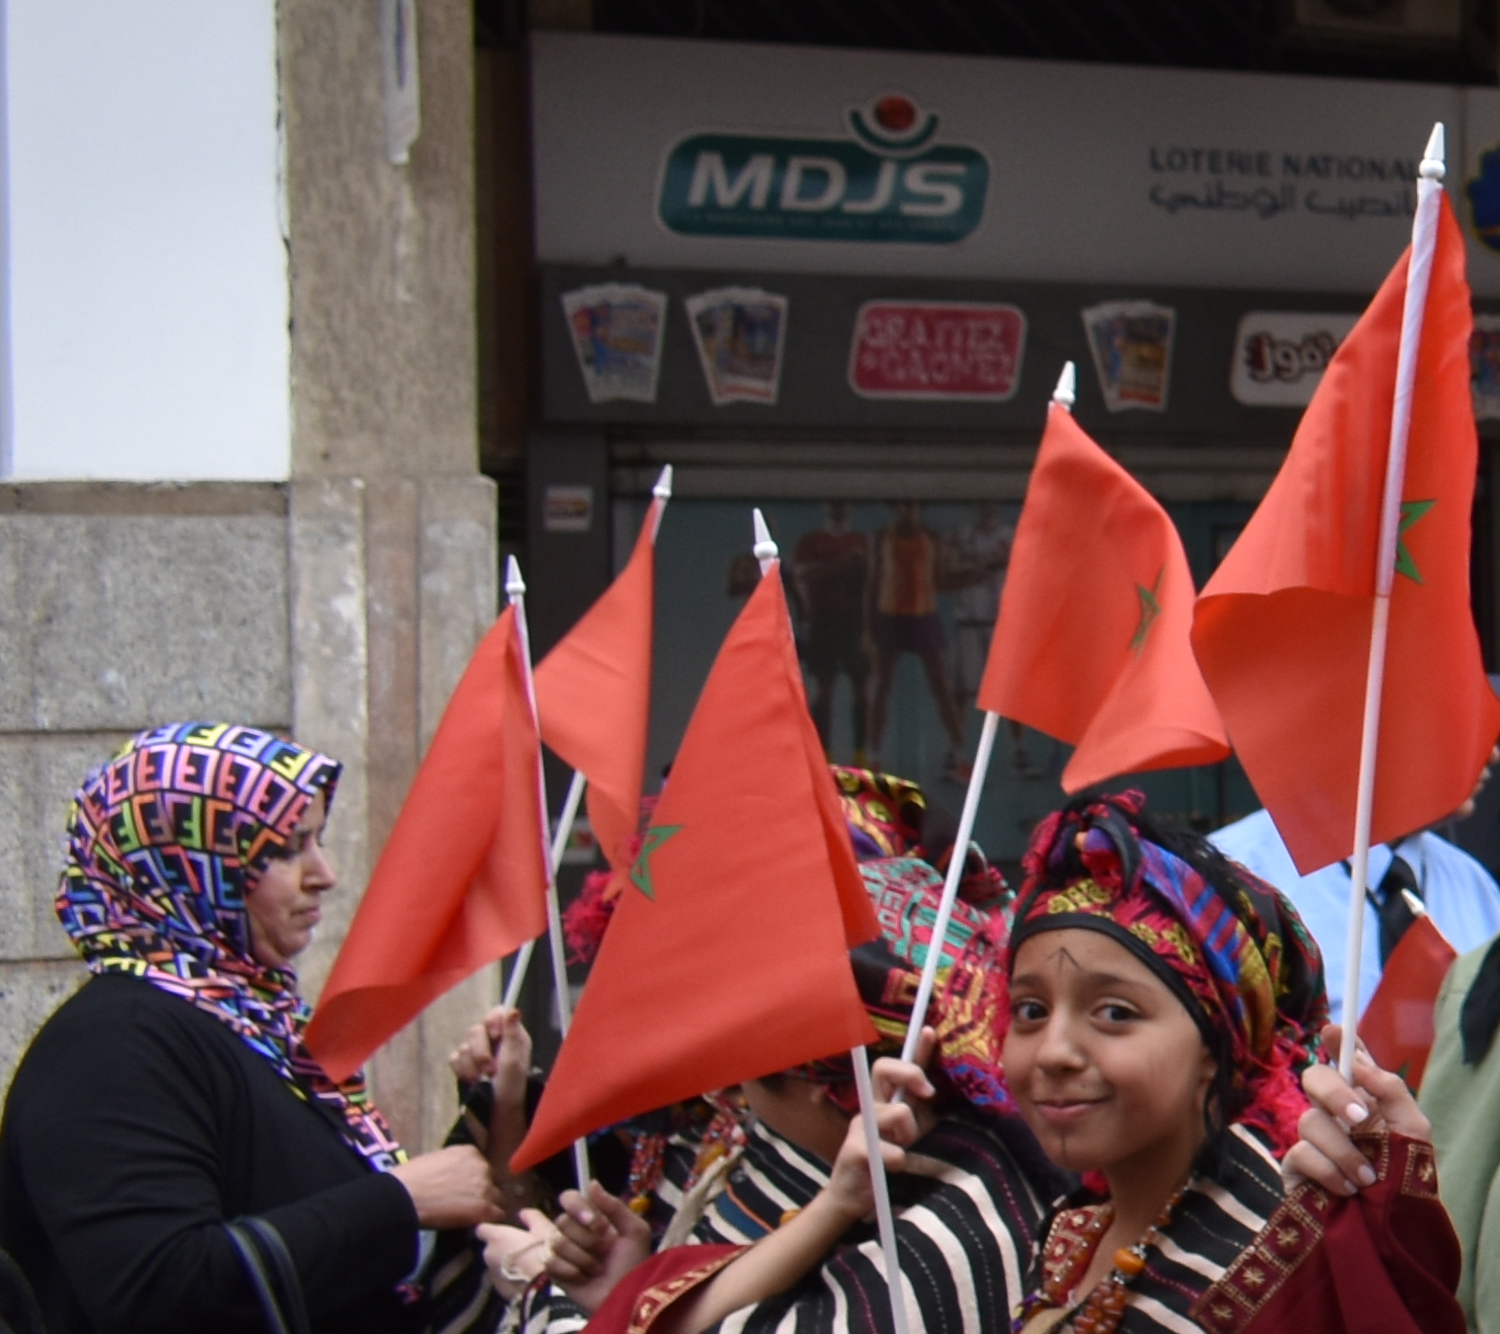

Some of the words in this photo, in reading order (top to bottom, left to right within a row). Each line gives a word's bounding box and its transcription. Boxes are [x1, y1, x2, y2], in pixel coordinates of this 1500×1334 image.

[687, 150, 968, 217] MDJS
[1150, 148, 1270, 177] LOTERIE
[1282, 153, 1417, 182] NATIONAL
